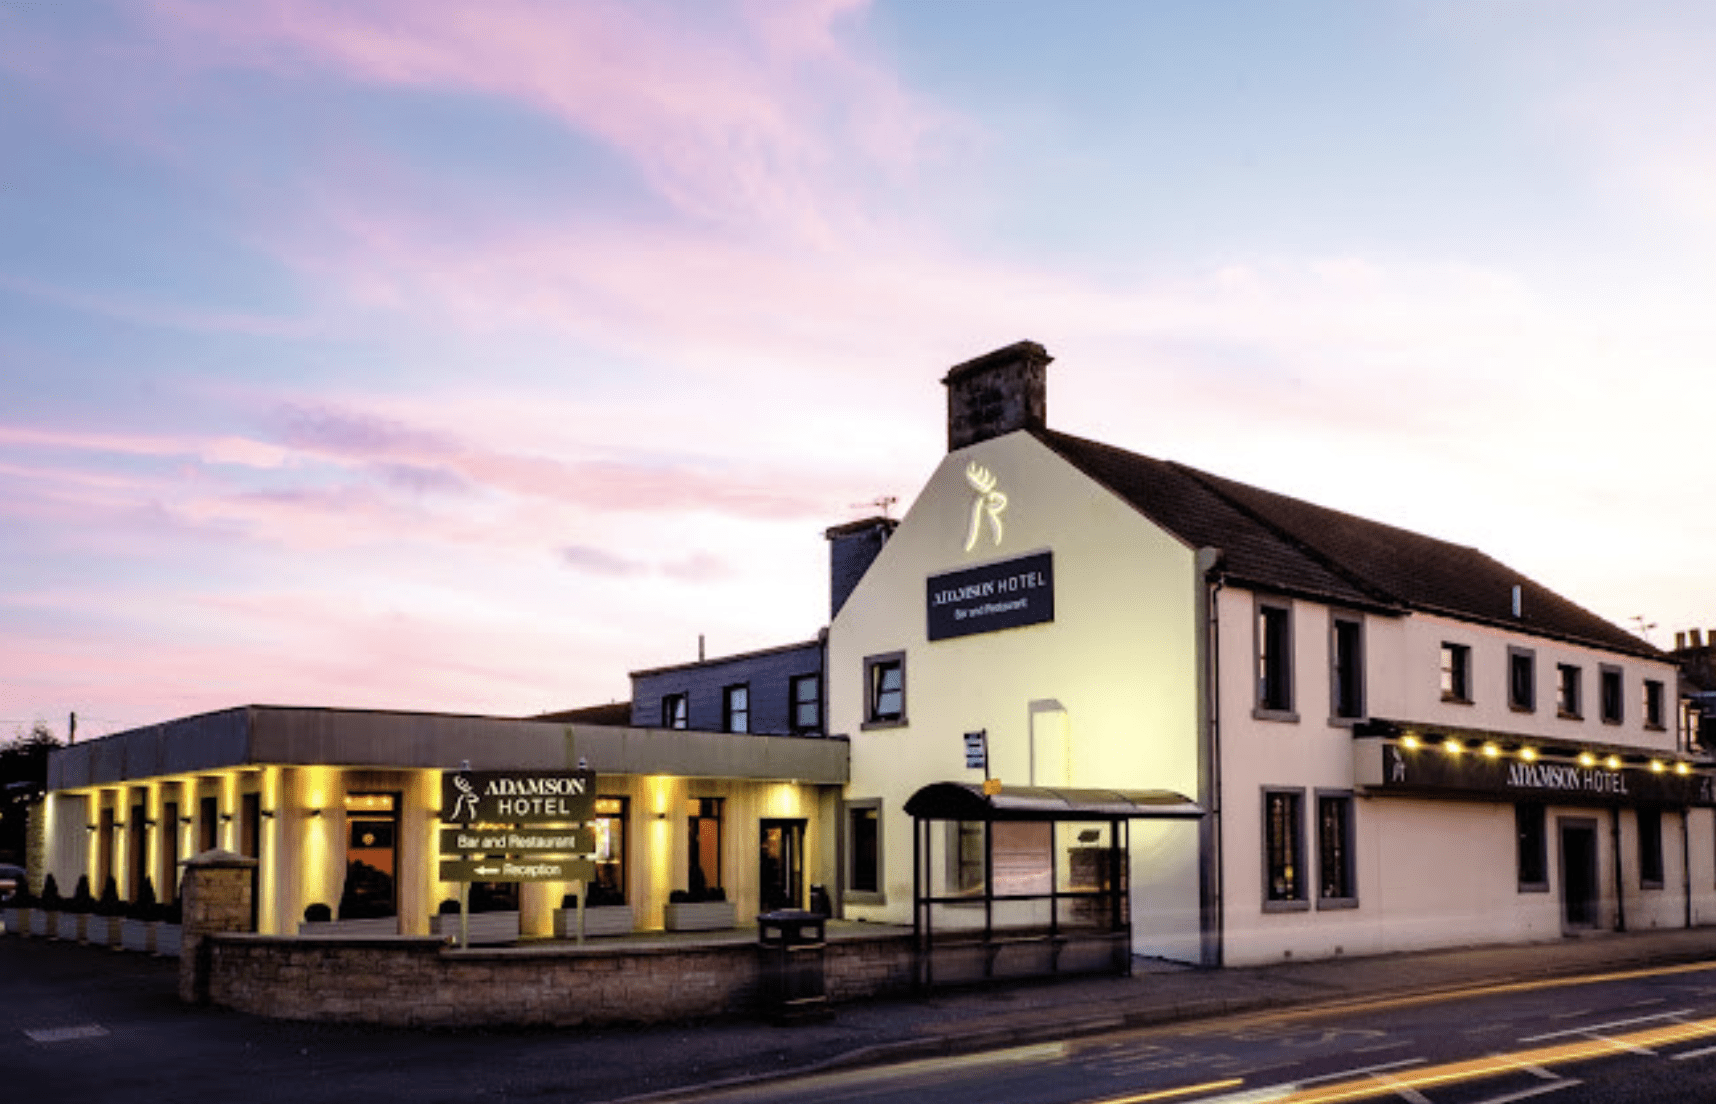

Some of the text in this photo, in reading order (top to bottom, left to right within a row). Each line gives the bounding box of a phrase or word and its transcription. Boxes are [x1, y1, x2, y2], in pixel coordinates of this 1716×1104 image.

[932, 571, 1047, 606] ADAMSON HOTEL
[968, 606, 983, 618] and
[984, 598, 1027, 613] Restaurant
[484, 778, 586, 795] ADAMSON
[1507, 763, 1628, 794] ADAMSON HOTEL
[498, 798, 570, 816] HOTEL
[457, 834, 575, 848] Bar and Restaurant
[502, 862, 562, 877] Reception
